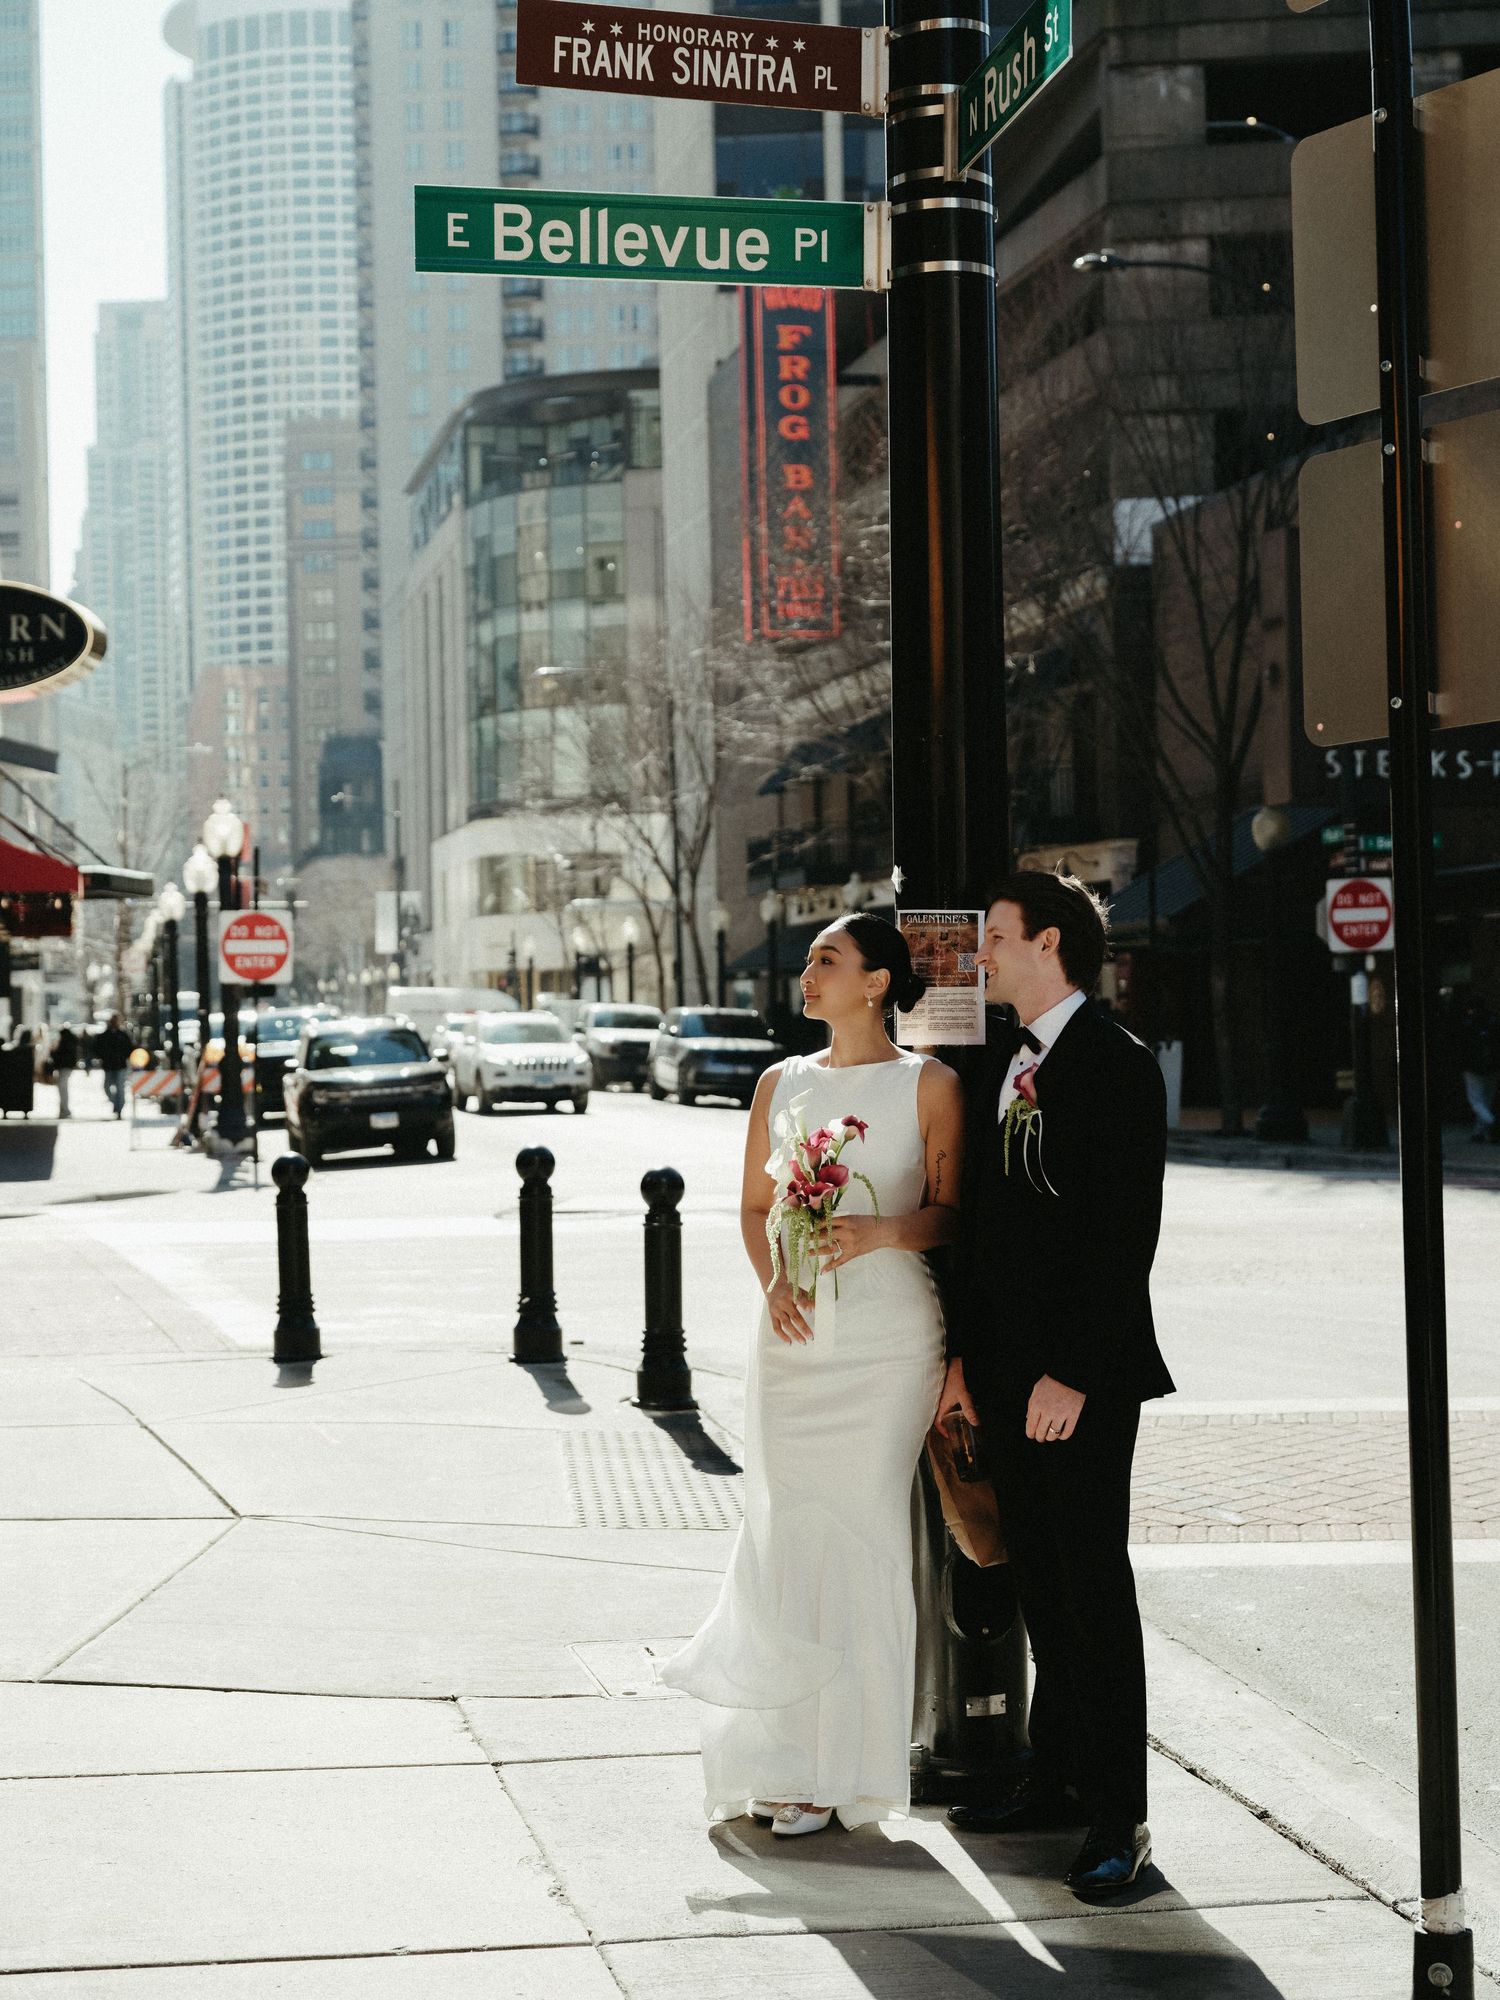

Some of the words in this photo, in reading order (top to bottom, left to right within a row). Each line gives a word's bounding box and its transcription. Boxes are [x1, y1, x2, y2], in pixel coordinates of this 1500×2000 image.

[638, 22, 754, 50] HONORARY
[554, 35, 654, 82] FRANK
[672, 47, 797, 94] SINATRA
[814, 65, 838, 91] PL
[969, 96, 978, 137] N
[984, 25, 1036, 132] Rush
[1044, 5, 1059, 52] St
[447, 212, 470, 248] E
[493, 202, 770, 272] Bellevue
[794, 227, 828, 263] Pl
[776, 324, 813, 441] FROG
[783, 464, 814, 551] BAR
[1337, 893, 1353, 906] DO
[1359, 891, 1382, 906] NOT
[230, 925, 249, 939] DO
[254, 924, 280, 939] NOT
[906, 914, 969, 924] GALENTINE'S
[1342, 923, 1379, 938] ENTER
[235, 955, 276, 970] ENTER
